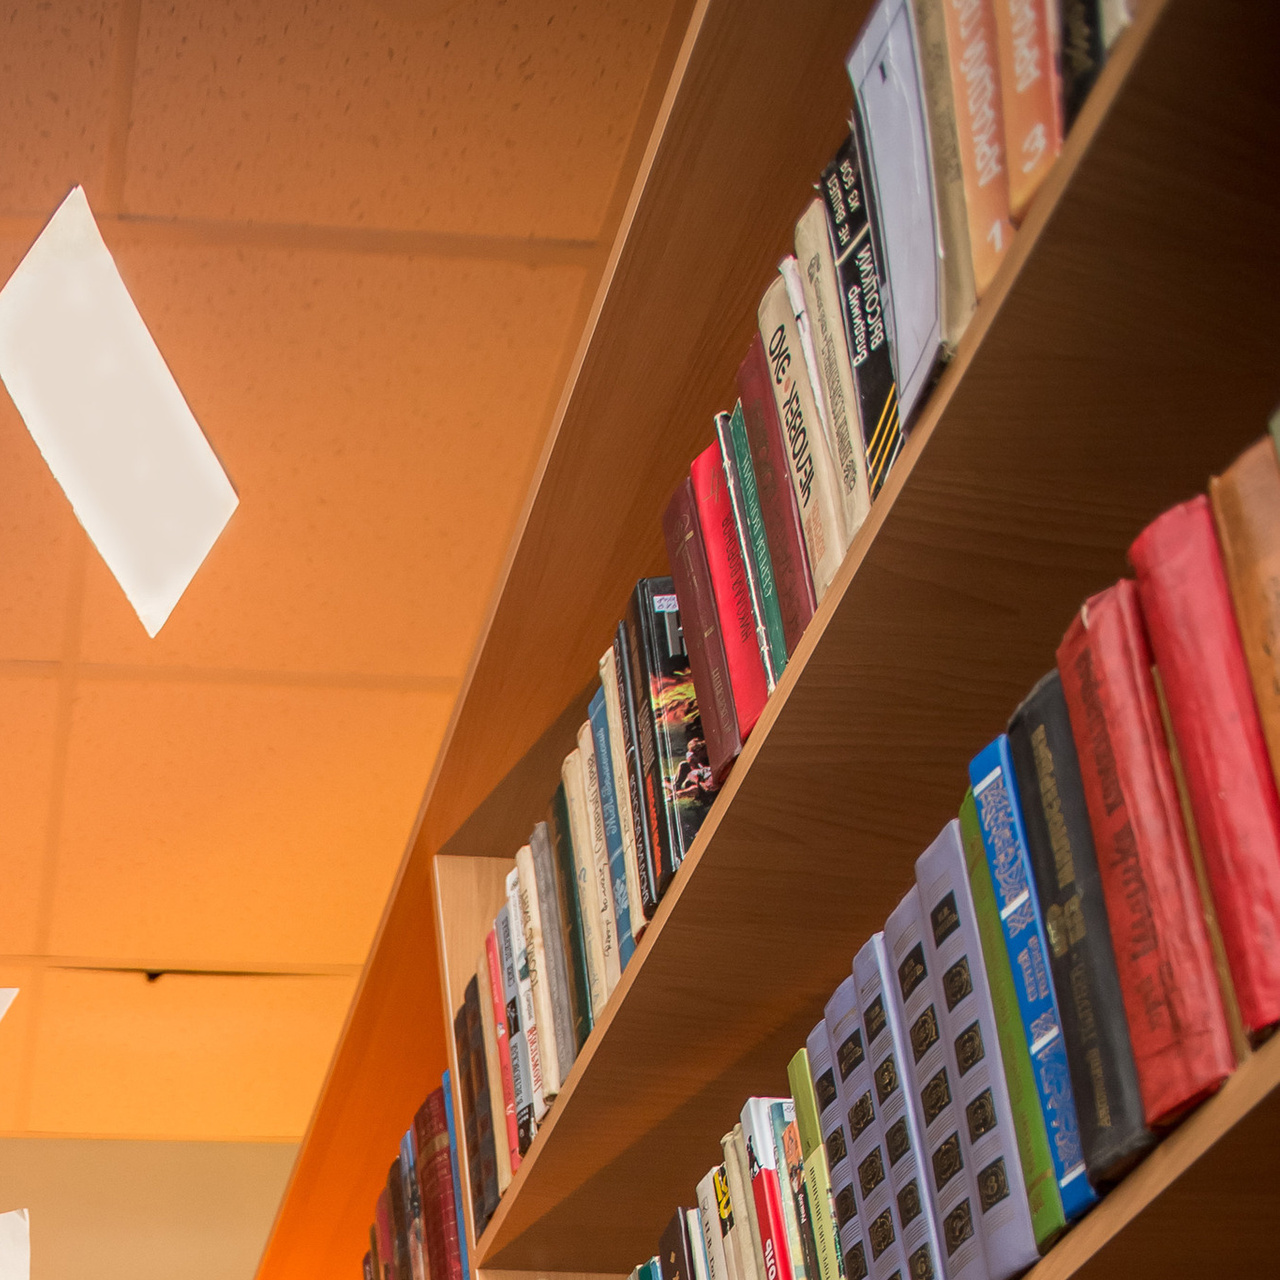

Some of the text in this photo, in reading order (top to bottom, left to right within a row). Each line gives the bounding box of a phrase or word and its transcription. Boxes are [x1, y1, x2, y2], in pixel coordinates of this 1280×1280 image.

[826, 171, 850, 249] НЕ ВЫШЕЛ
[839, 154, 859, 214] ИЗ БОЯ
[845, 283, 871, 367] Владимир
[853, 238, 888, 352] ВЫСОЦКИЙ
[766, 319, 816, 510] ЧЕЛОВЕК ЭХО
[739, 451, 773, 600] СЕРГЕЙ ВОРОНИН
[719, 508, 755, 645] НИКОЛАЙ ВОРОНОВ
[807, 1164, 823, 1227] ДИКАНЬКИ
[817, 1225, 827, 1254] БЛИЗ
